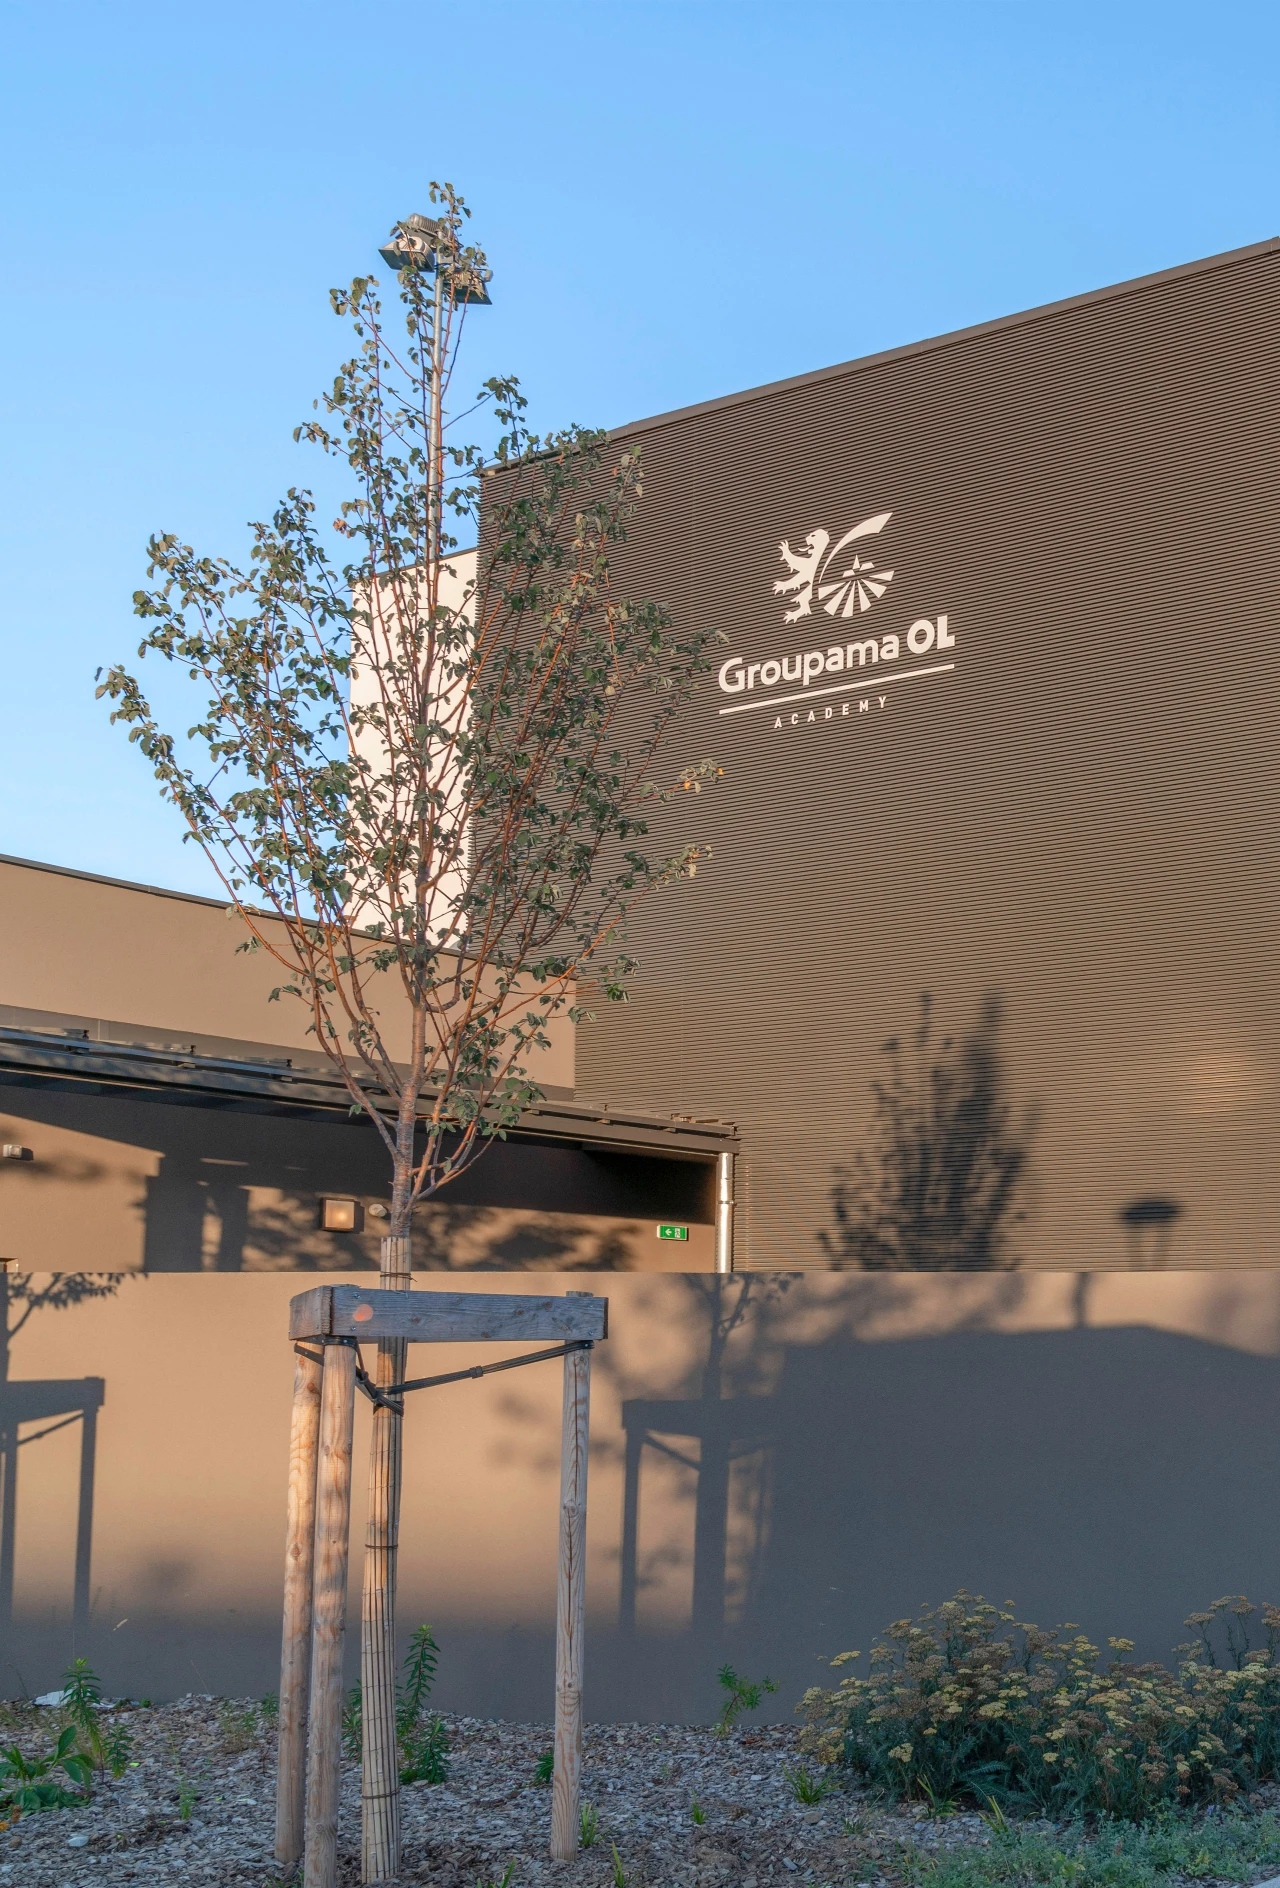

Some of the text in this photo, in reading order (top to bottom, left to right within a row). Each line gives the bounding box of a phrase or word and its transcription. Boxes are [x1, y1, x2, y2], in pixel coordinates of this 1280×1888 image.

[718, 614, 956, 693] Groupama OL
[773, 696, 887, 729] ACADEMY
